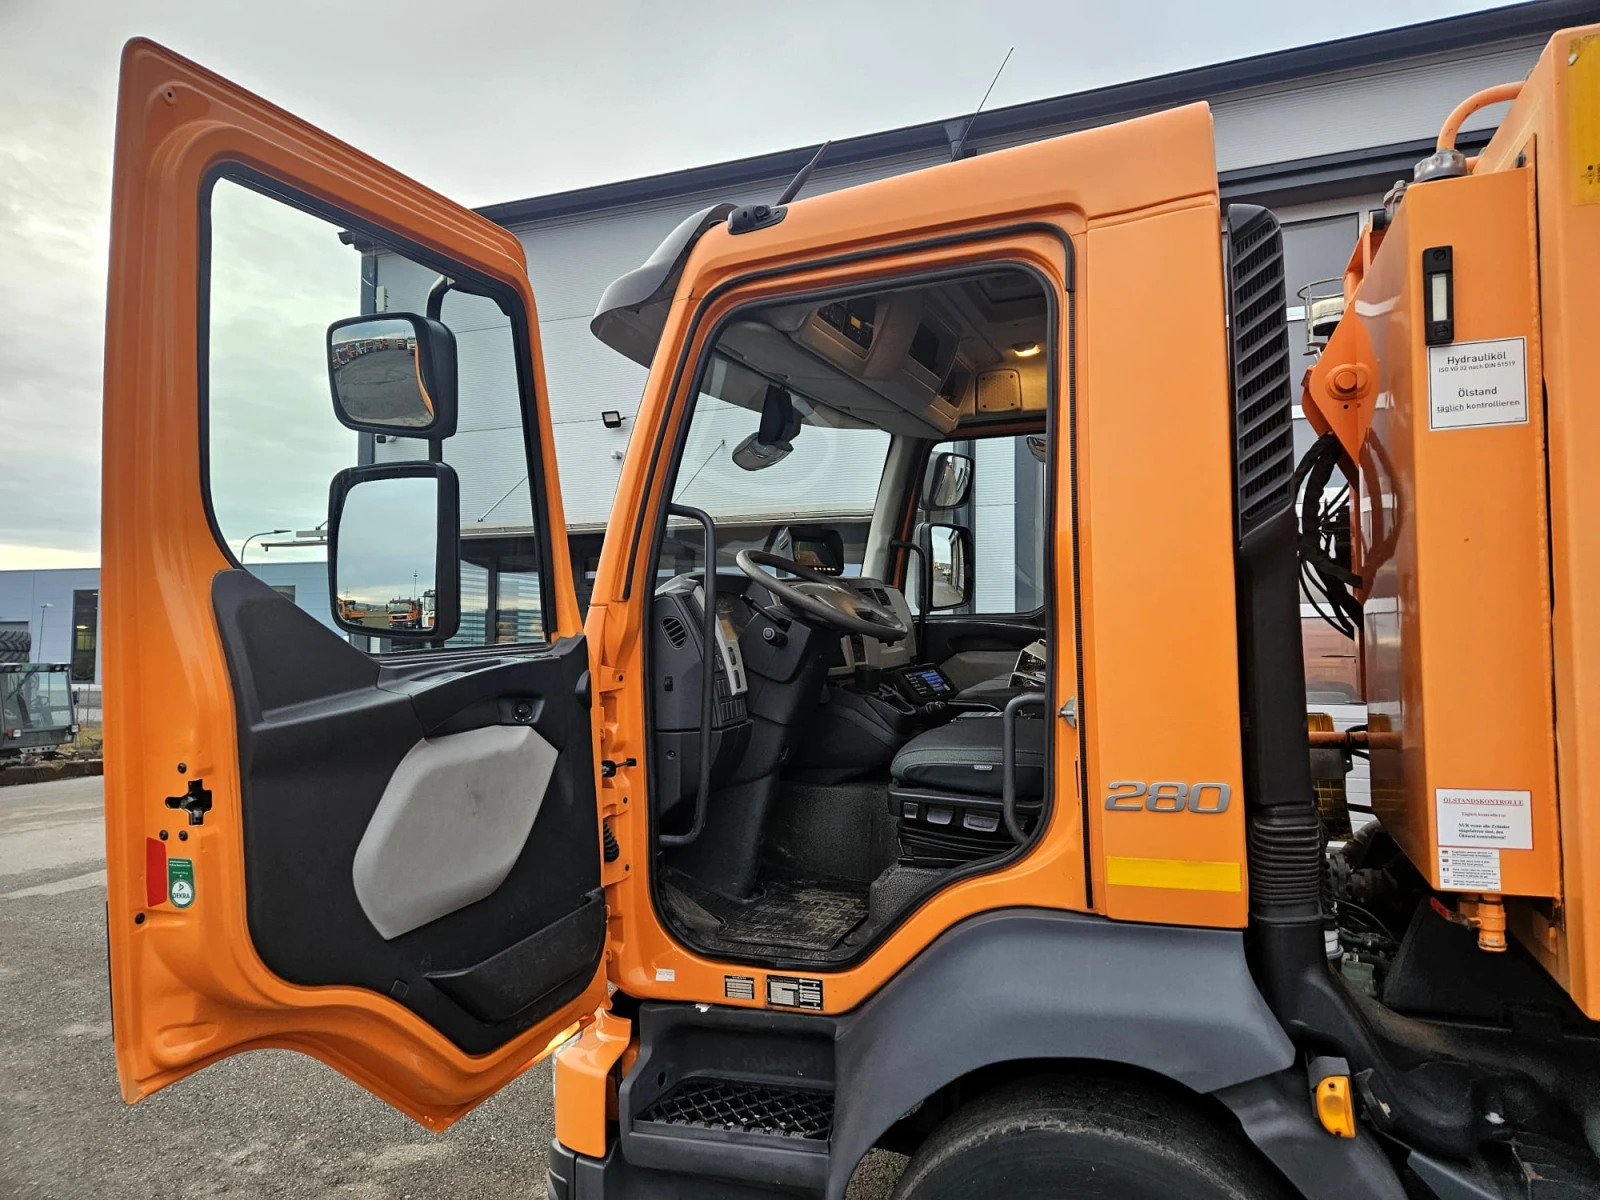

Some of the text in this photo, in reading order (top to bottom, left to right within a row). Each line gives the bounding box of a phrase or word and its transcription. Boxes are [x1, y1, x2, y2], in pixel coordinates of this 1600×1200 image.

[1447, 352, 1507, 365] Hydrauliköl
[1458, 386, 1497, 397] Ölstand
[1437, 400, 1520, 413] täglich kontrollieren
[1105, 781, 1231, 813] 280
[1443, 797, 1524, 806] ÖLSTANDSKONTROLLE
